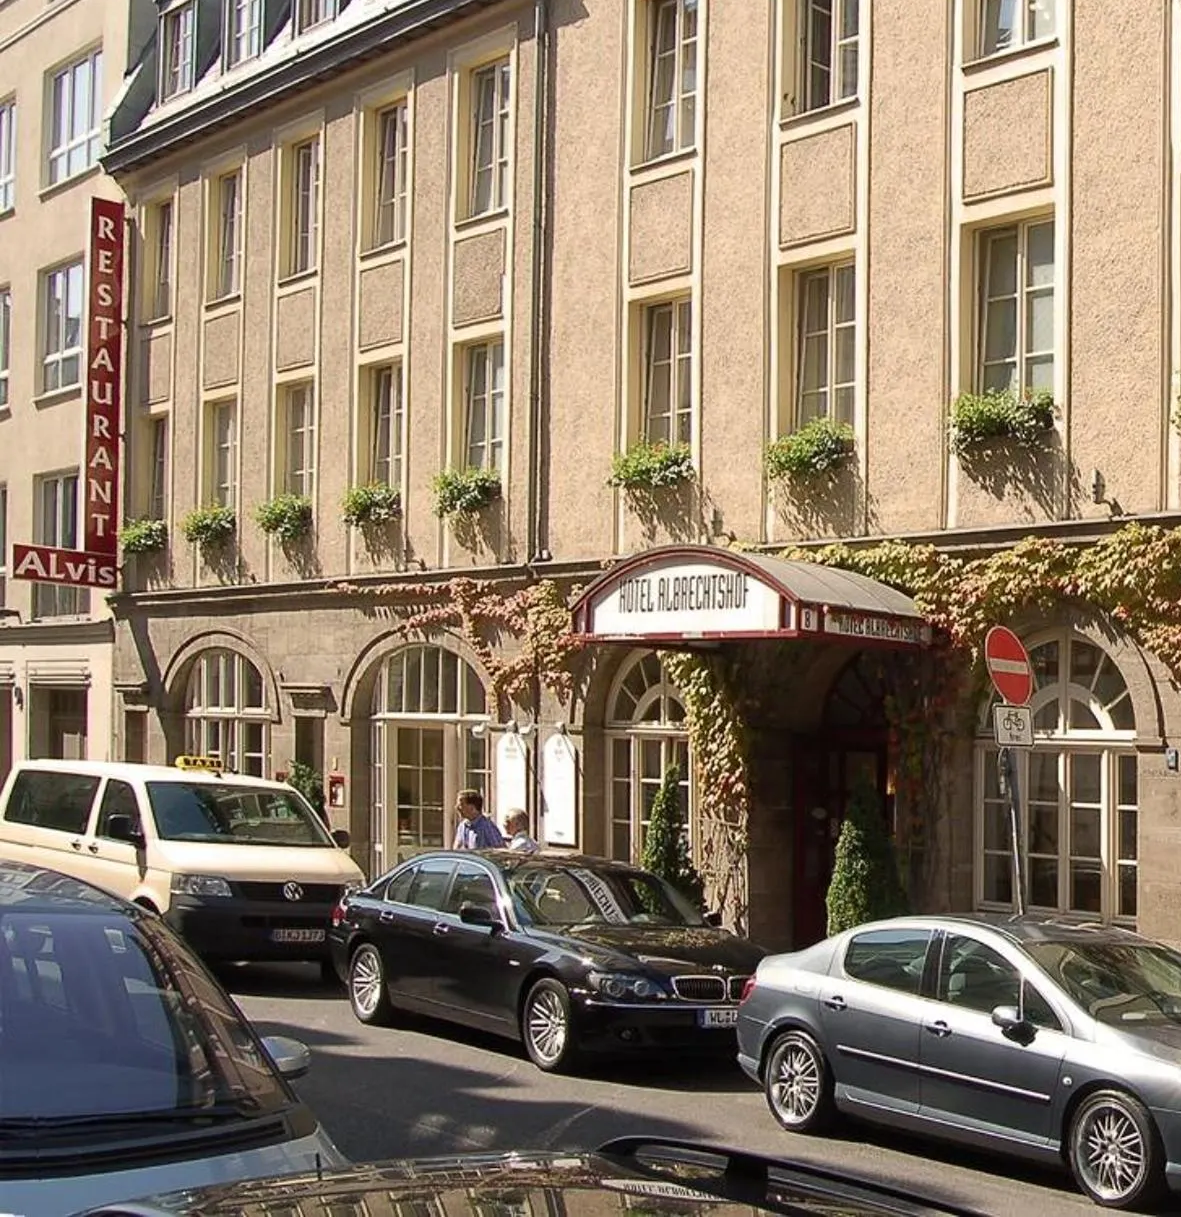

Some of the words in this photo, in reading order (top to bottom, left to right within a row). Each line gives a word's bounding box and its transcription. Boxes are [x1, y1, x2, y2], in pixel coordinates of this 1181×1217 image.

[88, 214, 116, 538] RESTAURANT
[619, 578, 655, 614] HOTEL
[657, 572, 750, 613] ALBRECHTSHOF
